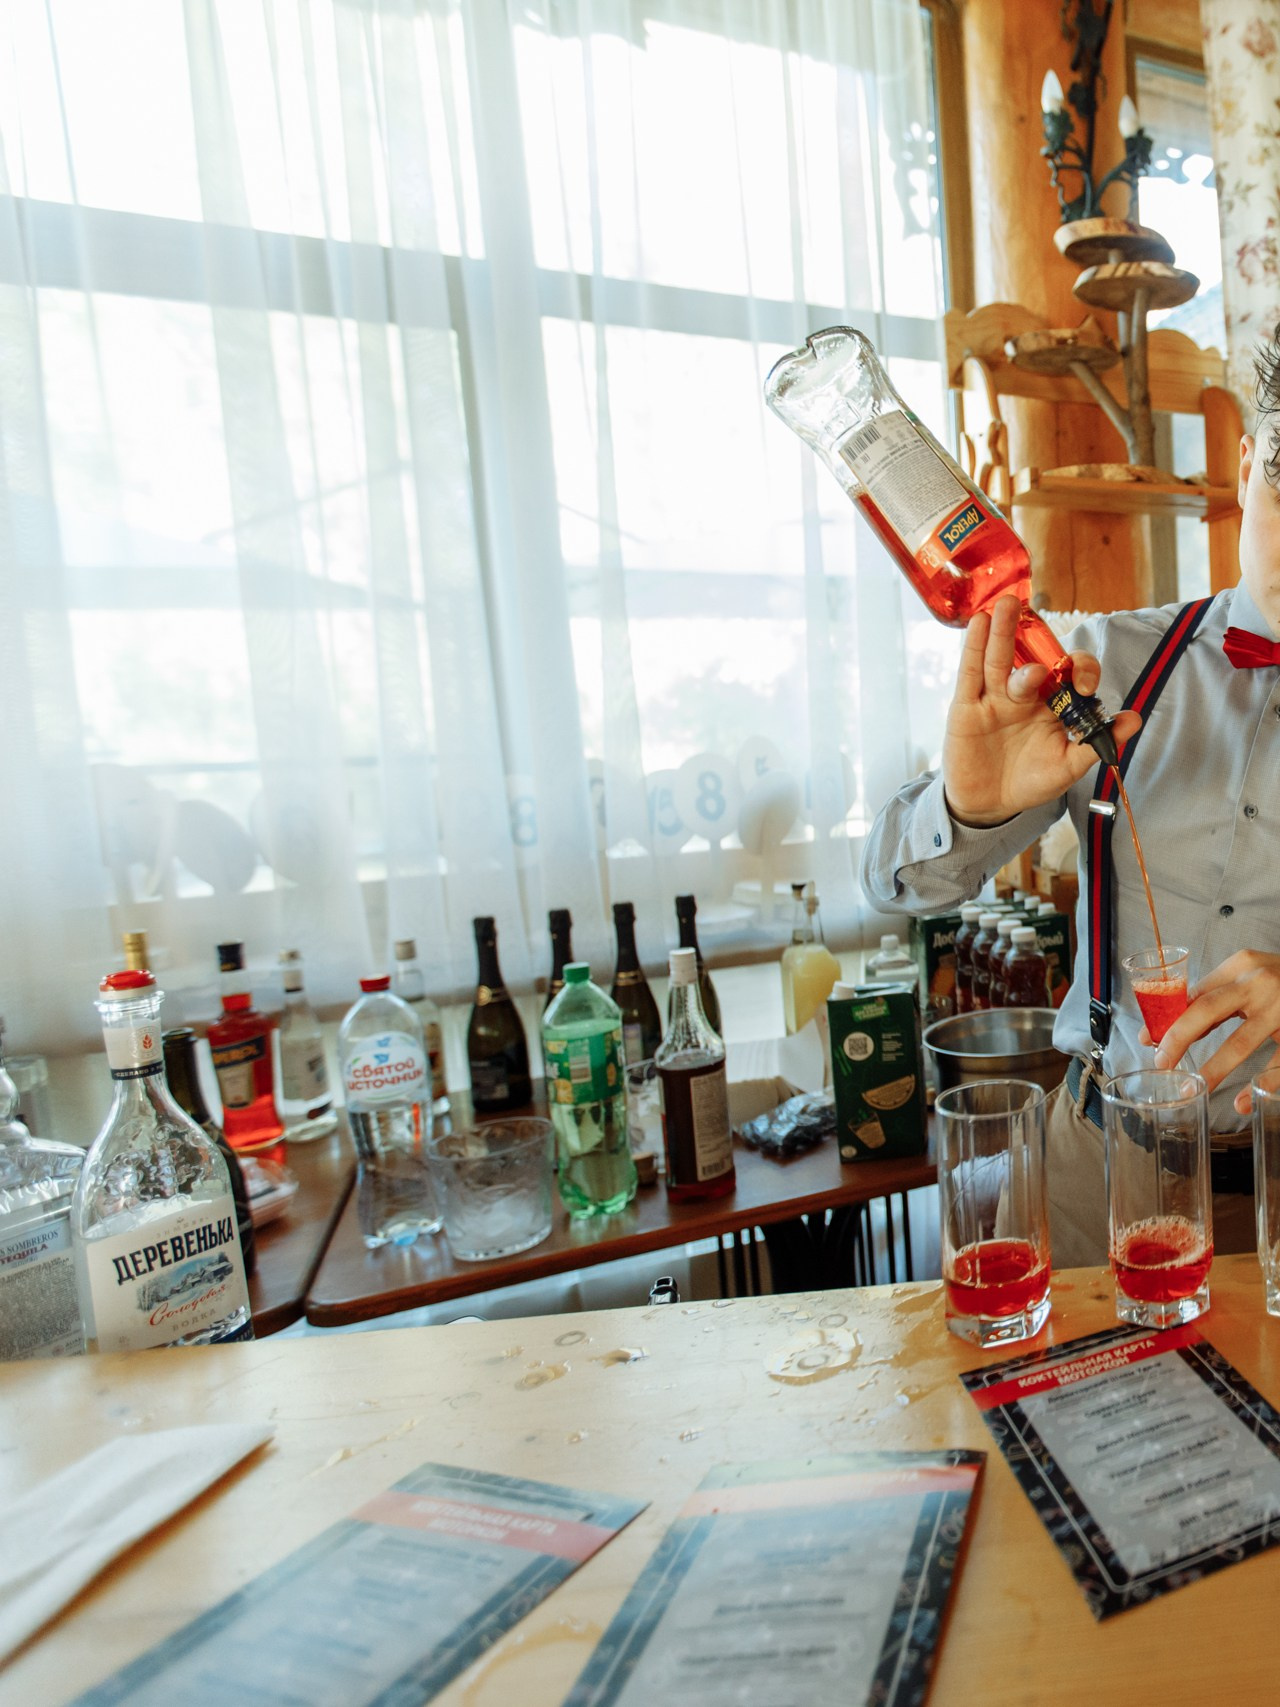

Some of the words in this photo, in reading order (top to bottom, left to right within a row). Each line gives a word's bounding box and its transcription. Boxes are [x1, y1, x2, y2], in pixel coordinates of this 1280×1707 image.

[943, 507, 980, 543] APEROL
[695, 770, 726, 822] 8
[0, 1243, 49, 1265] TEQUILA
[7, 1230, 60, 1253] SOMBREROS
[112, 1215, 235, 1286] ДЕРЕВЕНЬКА
[149, 1283, 227, 1327] Солодовая
[172, 1308, 218, 1332] ВОДКА
[1018, 1352, 1113, 1388] КОКТЕЙЛЬНАЯ
[1113, 1340, 1156, 1360] КАРТА
[1057, 1355, 1130, 1385] МОТОРКОН
